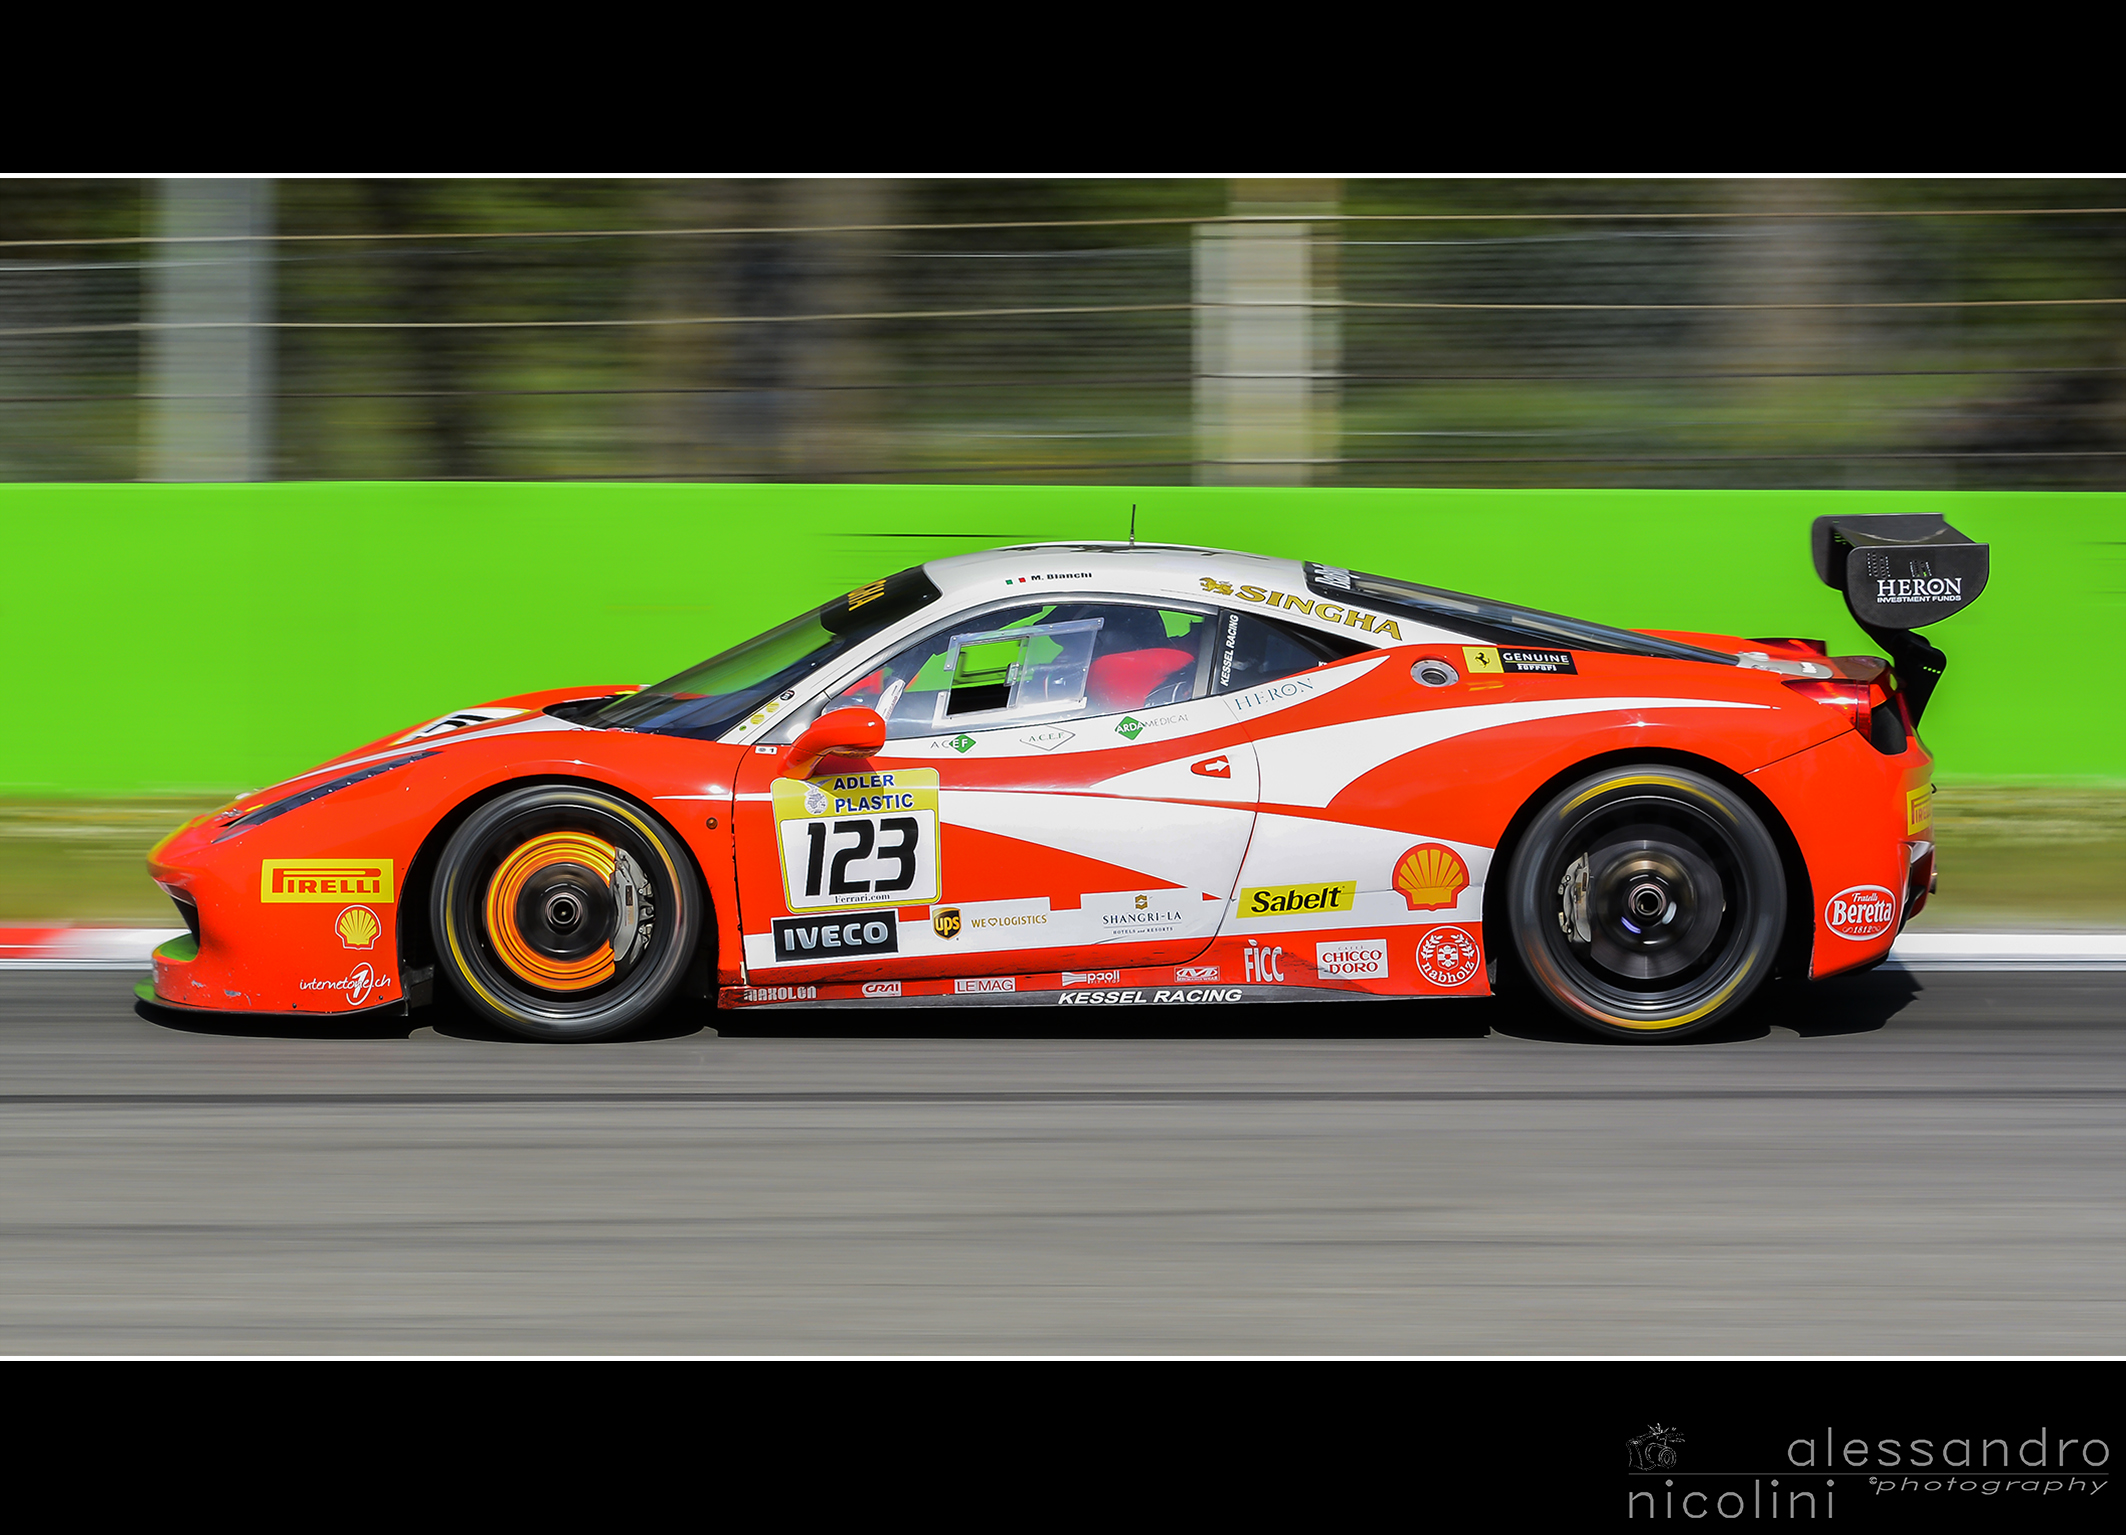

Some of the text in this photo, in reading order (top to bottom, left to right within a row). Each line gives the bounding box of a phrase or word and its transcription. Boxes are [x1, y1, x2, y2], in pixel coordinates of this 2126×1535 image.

[1877, 578, 1962, 597] HERON
[1235, 585, 1403, 641] SINGHA
[1220, 614, 1239, 687] KESSEL RACING
[1503, 652, 1569, 663] GENUINE
[1235, 677, 1314, 710] HERON
[930, 738, 969, 749] ACEF
[833, 774, 894, 790] ADLER
[835, 793, 914, 813] PLASTIC
[805, 817, 919, 896] 123
[272, 868, 381, 893] PIRELLI
[834, 893, 891, 903] Ferrari.com
[1251, 886, 1341, 913] Sabelt
[971, 914, 1047, 928] WE LOGISTICS
[1103, 911, 1182, 925] SHANGRI-LA
[1832, 900, 1891, 925] Beretta
[784, 922, 889, 950] IVECO
[1853, 925, 1873, 934] 1812
[1244, 946, 1286, 983] FICC
[1322, 949, 1383, 964] CHICCO
[1330, 961, 1379, 975] D'ORO
[1421, 961, 1476, 984] nabholz
[864, 983, 900, 995] CRAI
[1058, 989, 1243, 1005] KESSEL RACING
